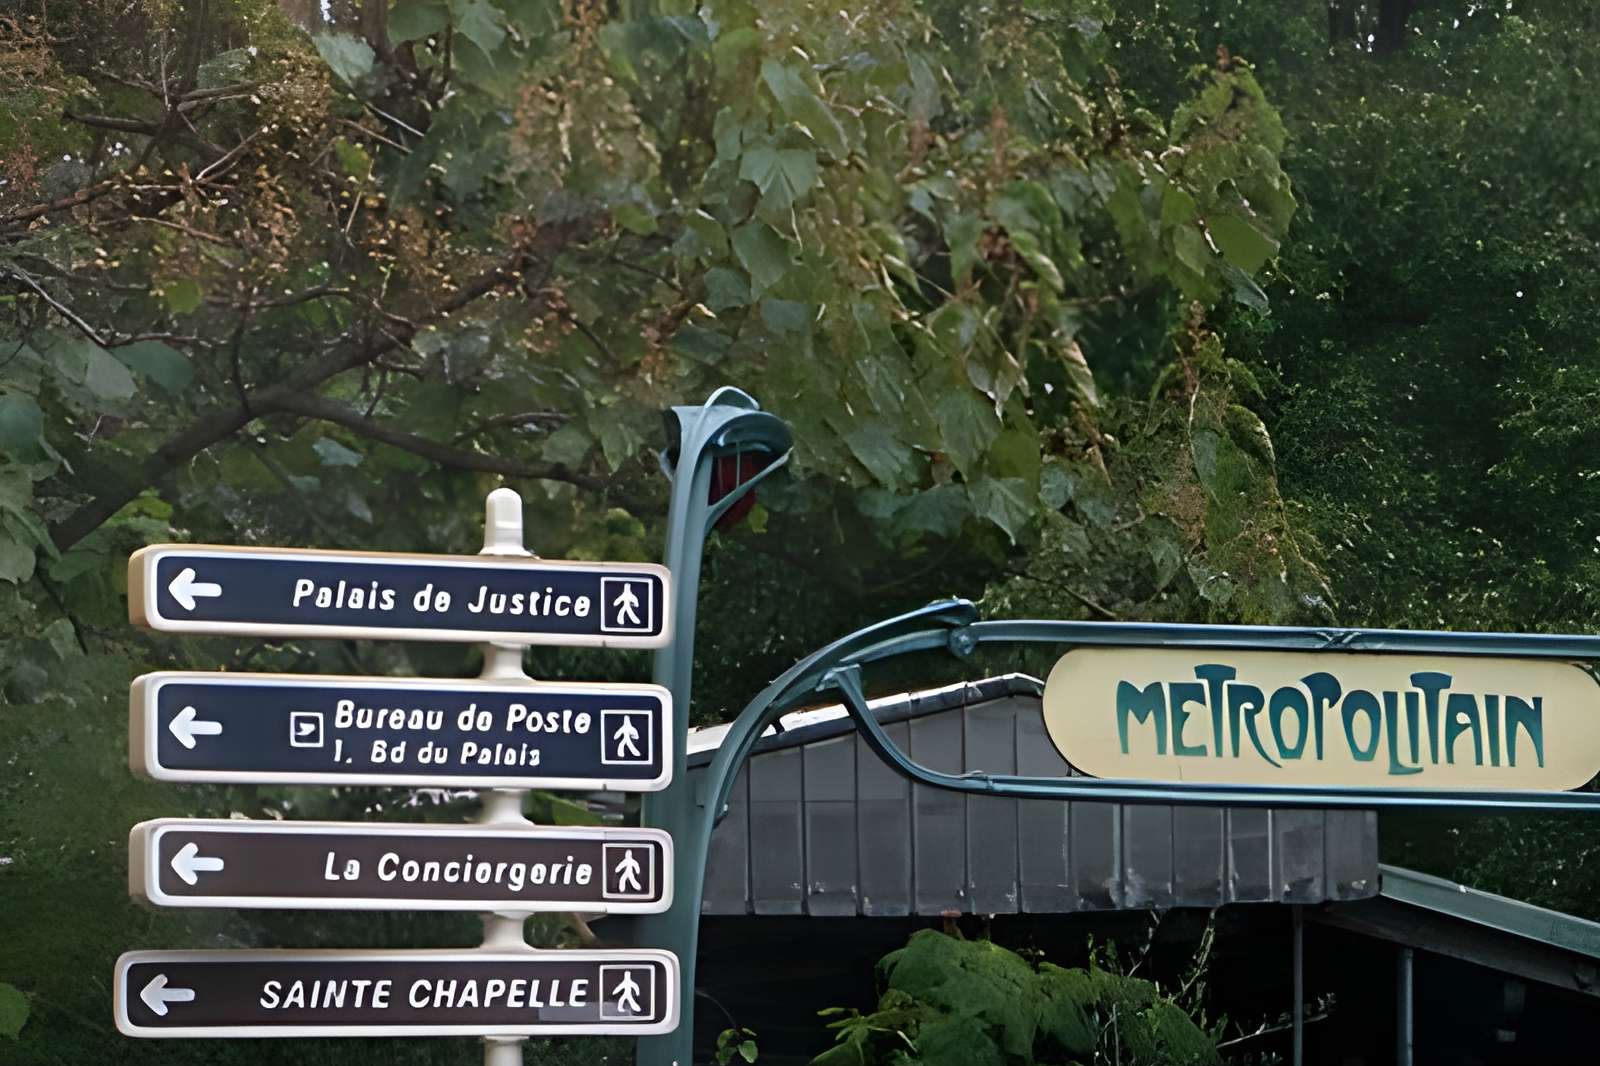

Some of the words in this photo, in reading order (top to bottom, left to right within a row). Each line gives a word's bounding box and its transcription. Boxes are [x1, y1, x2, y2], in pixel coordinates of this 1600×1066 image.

[292, 578, 396, 611] Palais
[413, 583, 452, 613] de
[467, 585, 591, 618] Justice
[334, 699, 444, 731] Bureau
[457, 703, 493, 732] de
[505, 703, 592, 734] Poste
[1116, 663, 1545, 776] METROPOLITAIN
[370, 739, 407, 764] Bd
[417, 740, 449, 765] du
[459, 741, 540, 767] Palais
[324, 851, 361, 881] La
[377, 851, 593, 892] Conciergerie
[259, 979, 392, 1009] SAINTE
[408, 978, 589, 1009] CHAPELLE
